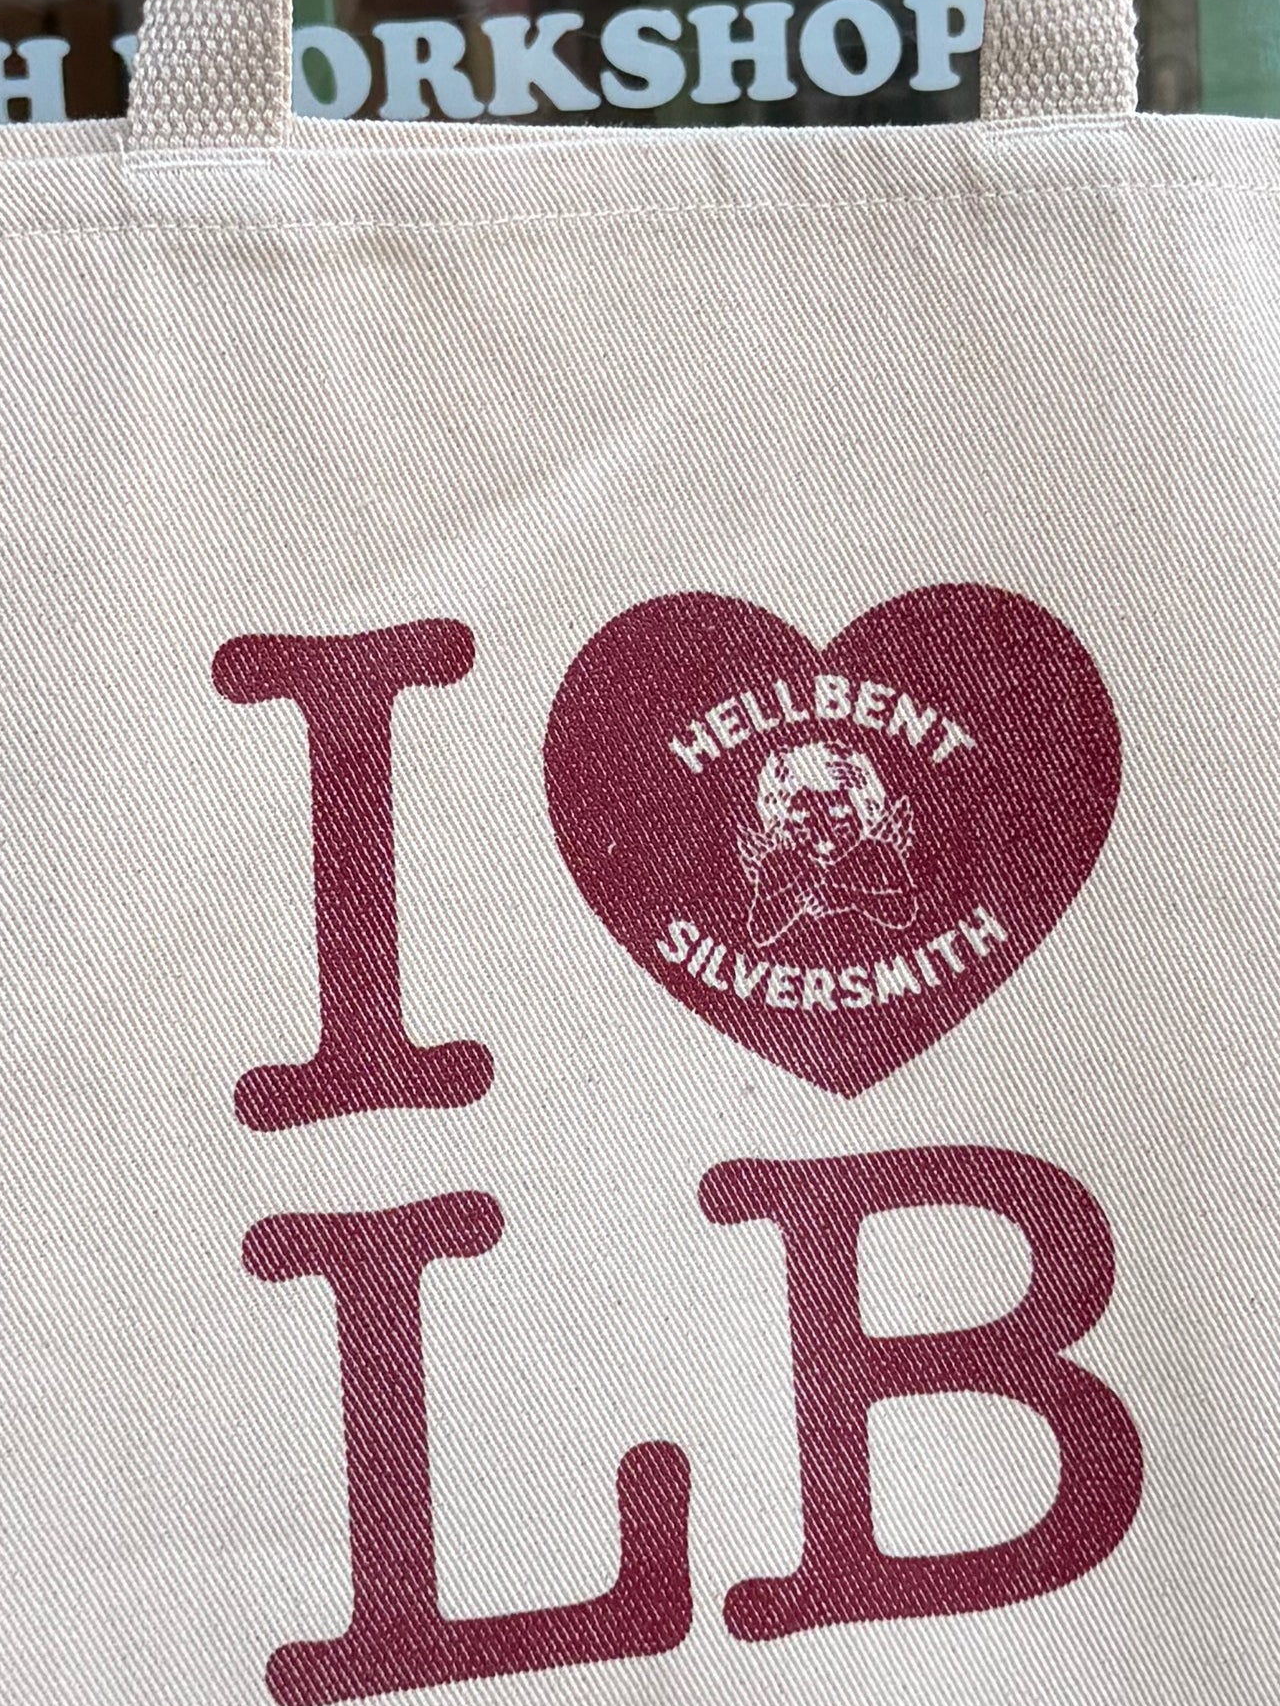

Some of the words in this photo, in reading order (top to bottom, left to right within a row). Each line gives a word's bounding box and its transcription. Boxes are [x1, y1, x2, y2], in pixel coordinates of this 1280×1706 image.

[669, 673, 977, 774] HELLBENT
[212, 617, 496, 1133] I
[656, 905, 1009, 1013] SILVERSMITH
